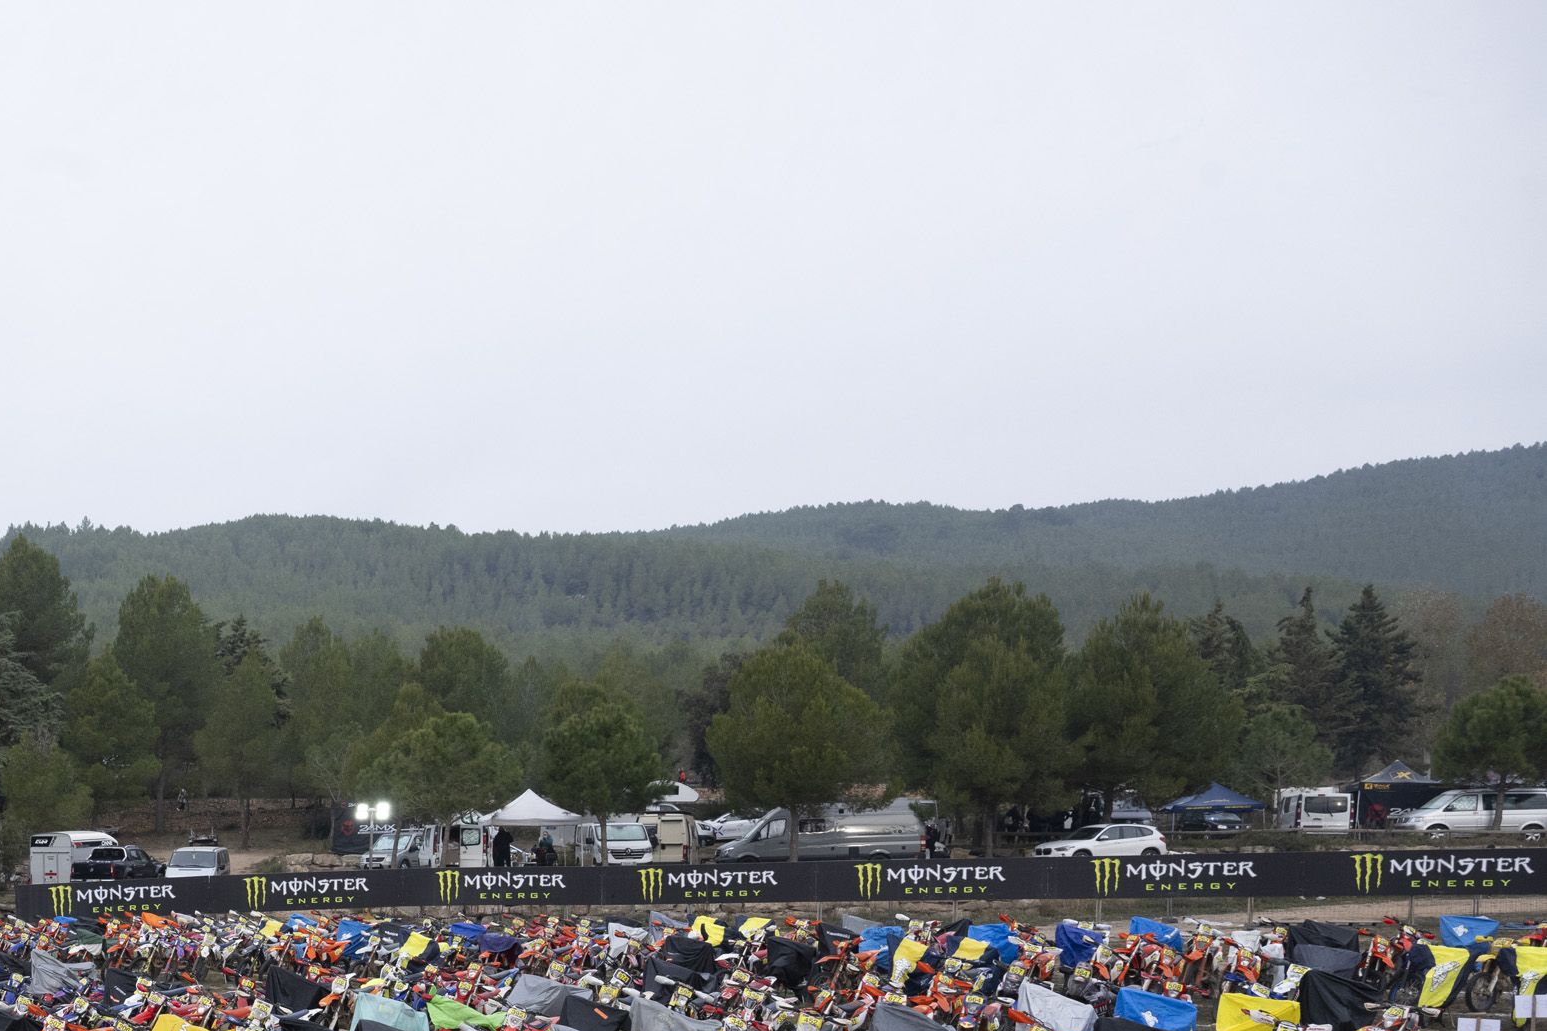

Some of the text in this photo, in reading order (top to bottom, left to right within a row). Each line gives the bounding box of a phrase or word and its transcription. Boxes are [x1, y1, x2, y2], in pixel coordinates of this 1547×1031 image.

[887, 864, 1007, 883] MONSTER
[1126, 860, 1257, 880] MONSTER
[1389, 853, 1535, 877] MONSTER
[271, 877, 370, 896] MONSTER
[464, 870, 566, 889] MONSTER
[668, 870, 778, 889] MONSTER
[1145, 882, 1237, 890] ENERGY
[1410, 879, 1512, 889] ENERGY
[76, 885, 176, 904] MONSTER
[684, 890, 762, 898] ENERGY
[904, 886, 988, 894] ENERGY
[92, 903, 164, 913] ENERGY
[286, 896, 356, 905] ENERGY
